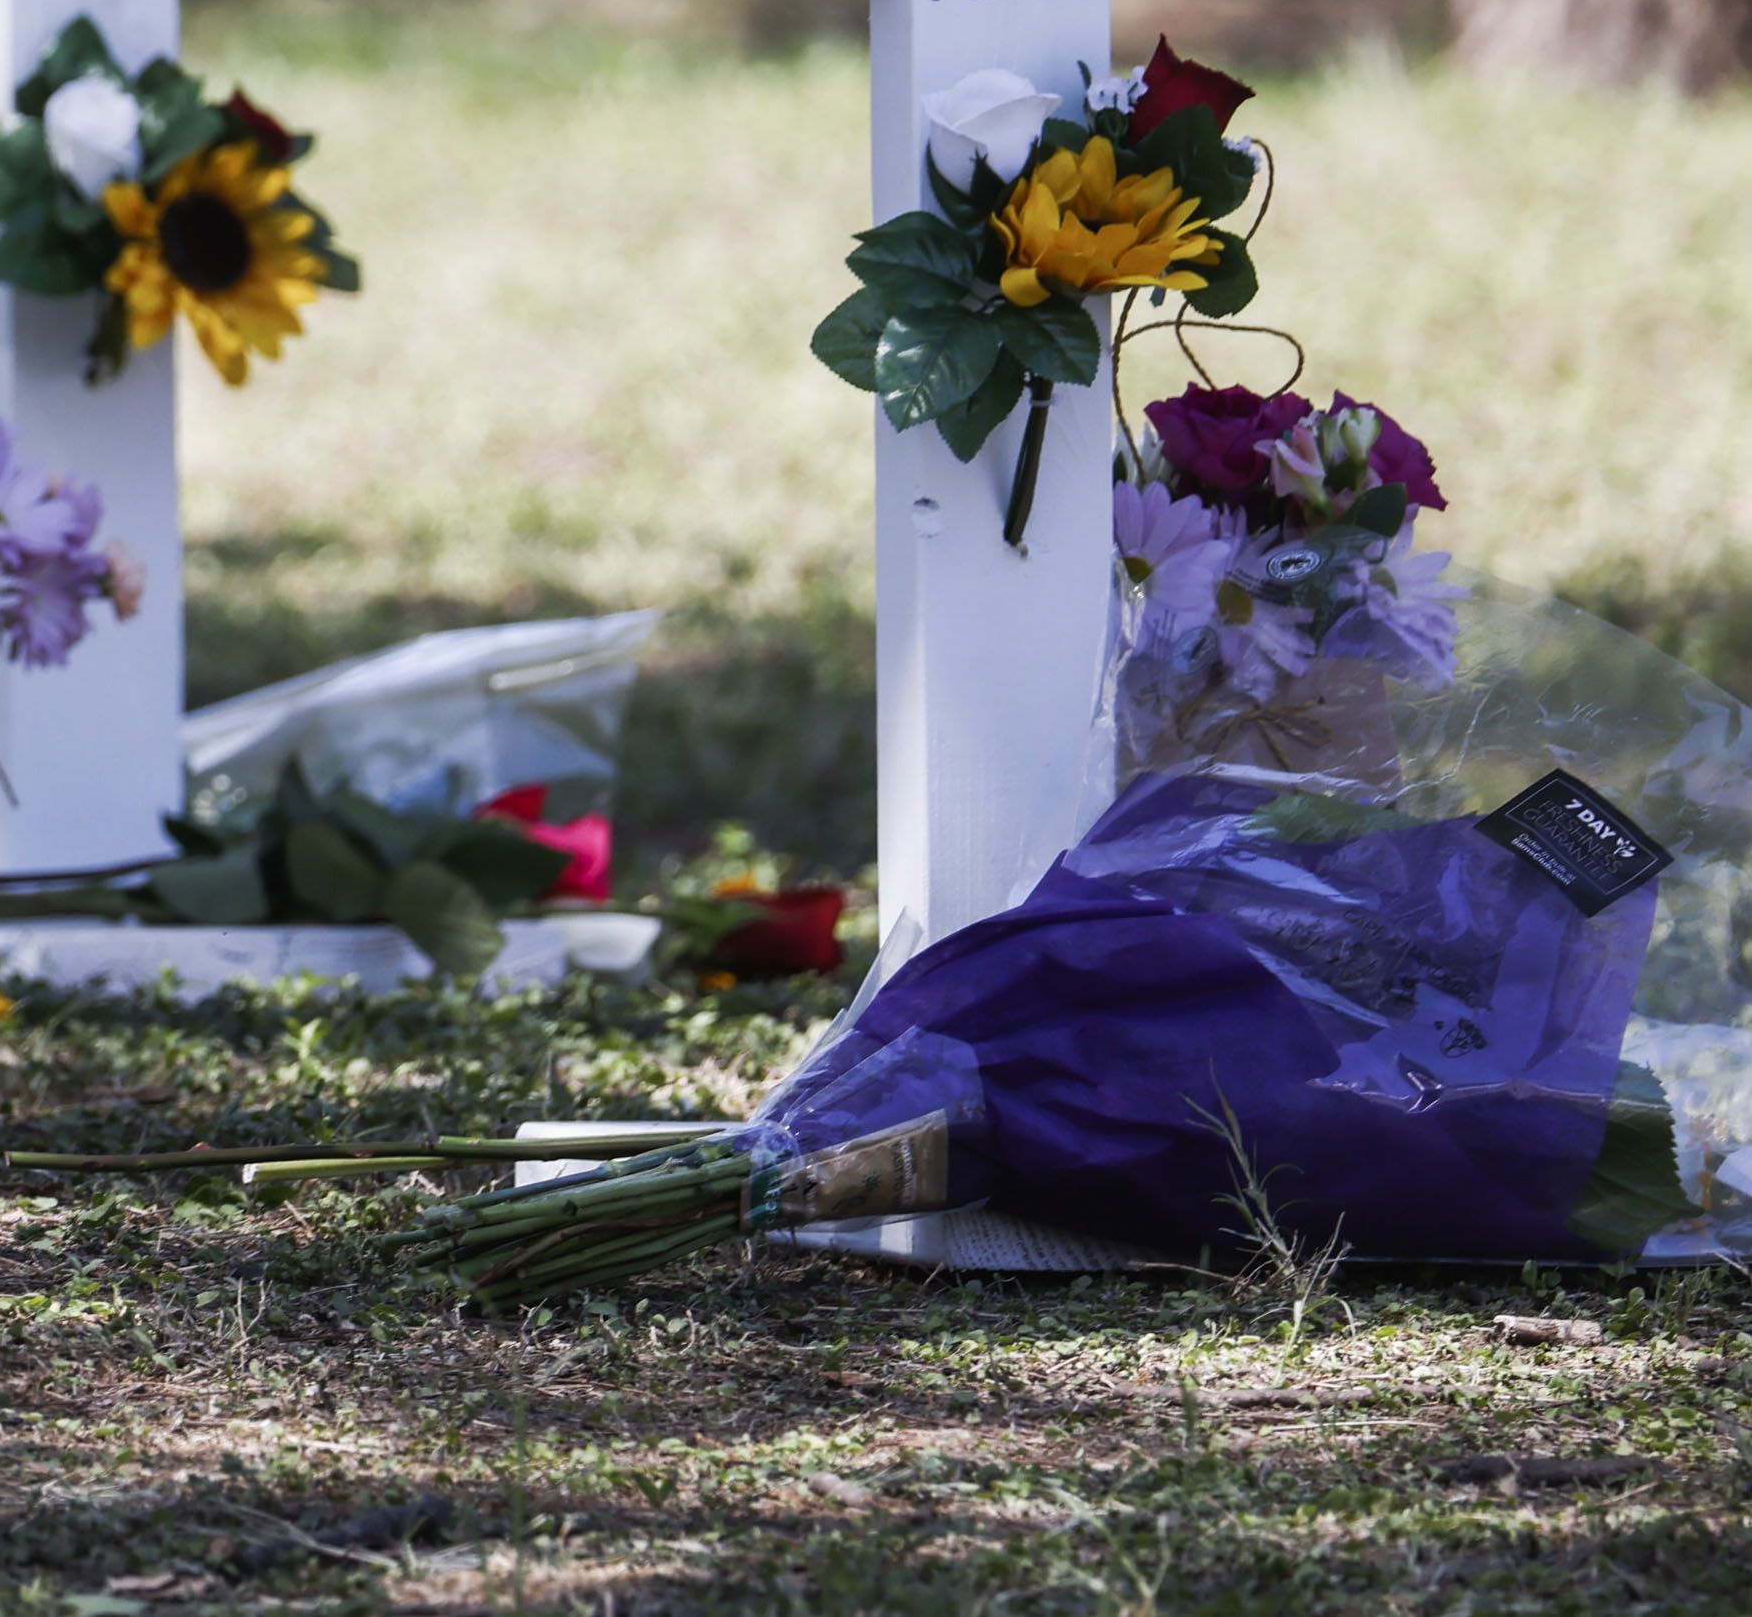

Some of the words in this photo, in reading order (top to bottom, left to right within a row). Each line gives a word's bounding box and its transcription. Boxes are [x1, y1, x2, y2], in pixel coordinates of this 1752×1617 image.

[1538, 799, 1624, 875] FRESHNESS
[1564, 798, 1583, 810] 7
[1577, 808, 1617, 839] DAY
